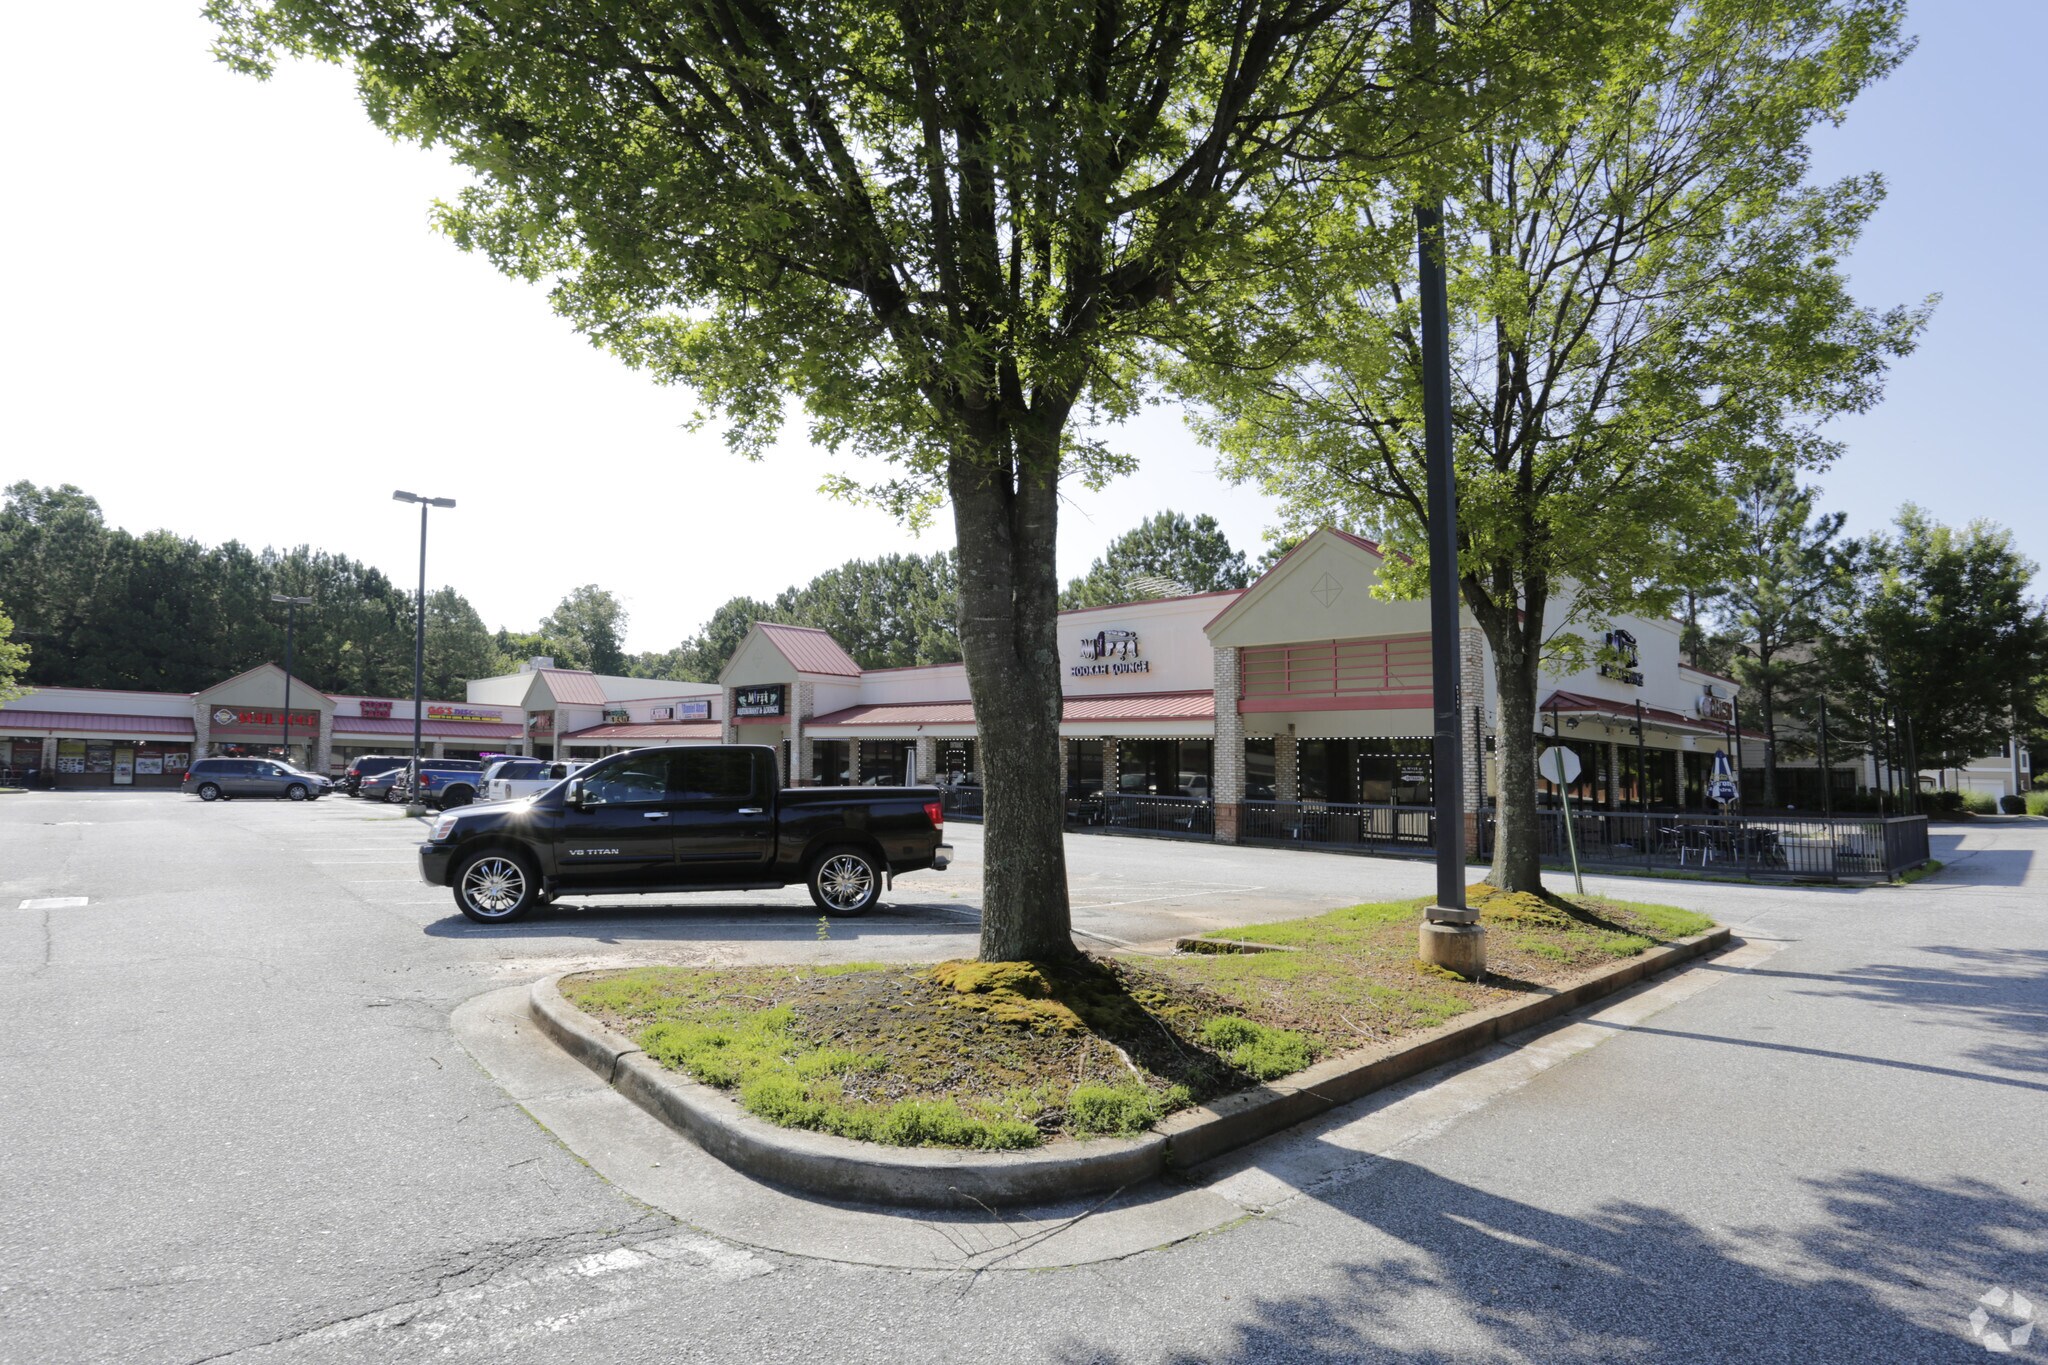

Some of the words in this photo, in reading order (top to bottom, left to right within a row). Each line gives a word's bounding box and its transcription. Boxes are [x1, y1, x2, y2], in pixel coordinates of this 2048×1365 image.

[1071, 664, 1109, 676] HOOKAH
[1112, 660, 1149, 675] LOUNGE
[360, 700, 393, 709] STATE
[361, 709, 390, 718] FARM
